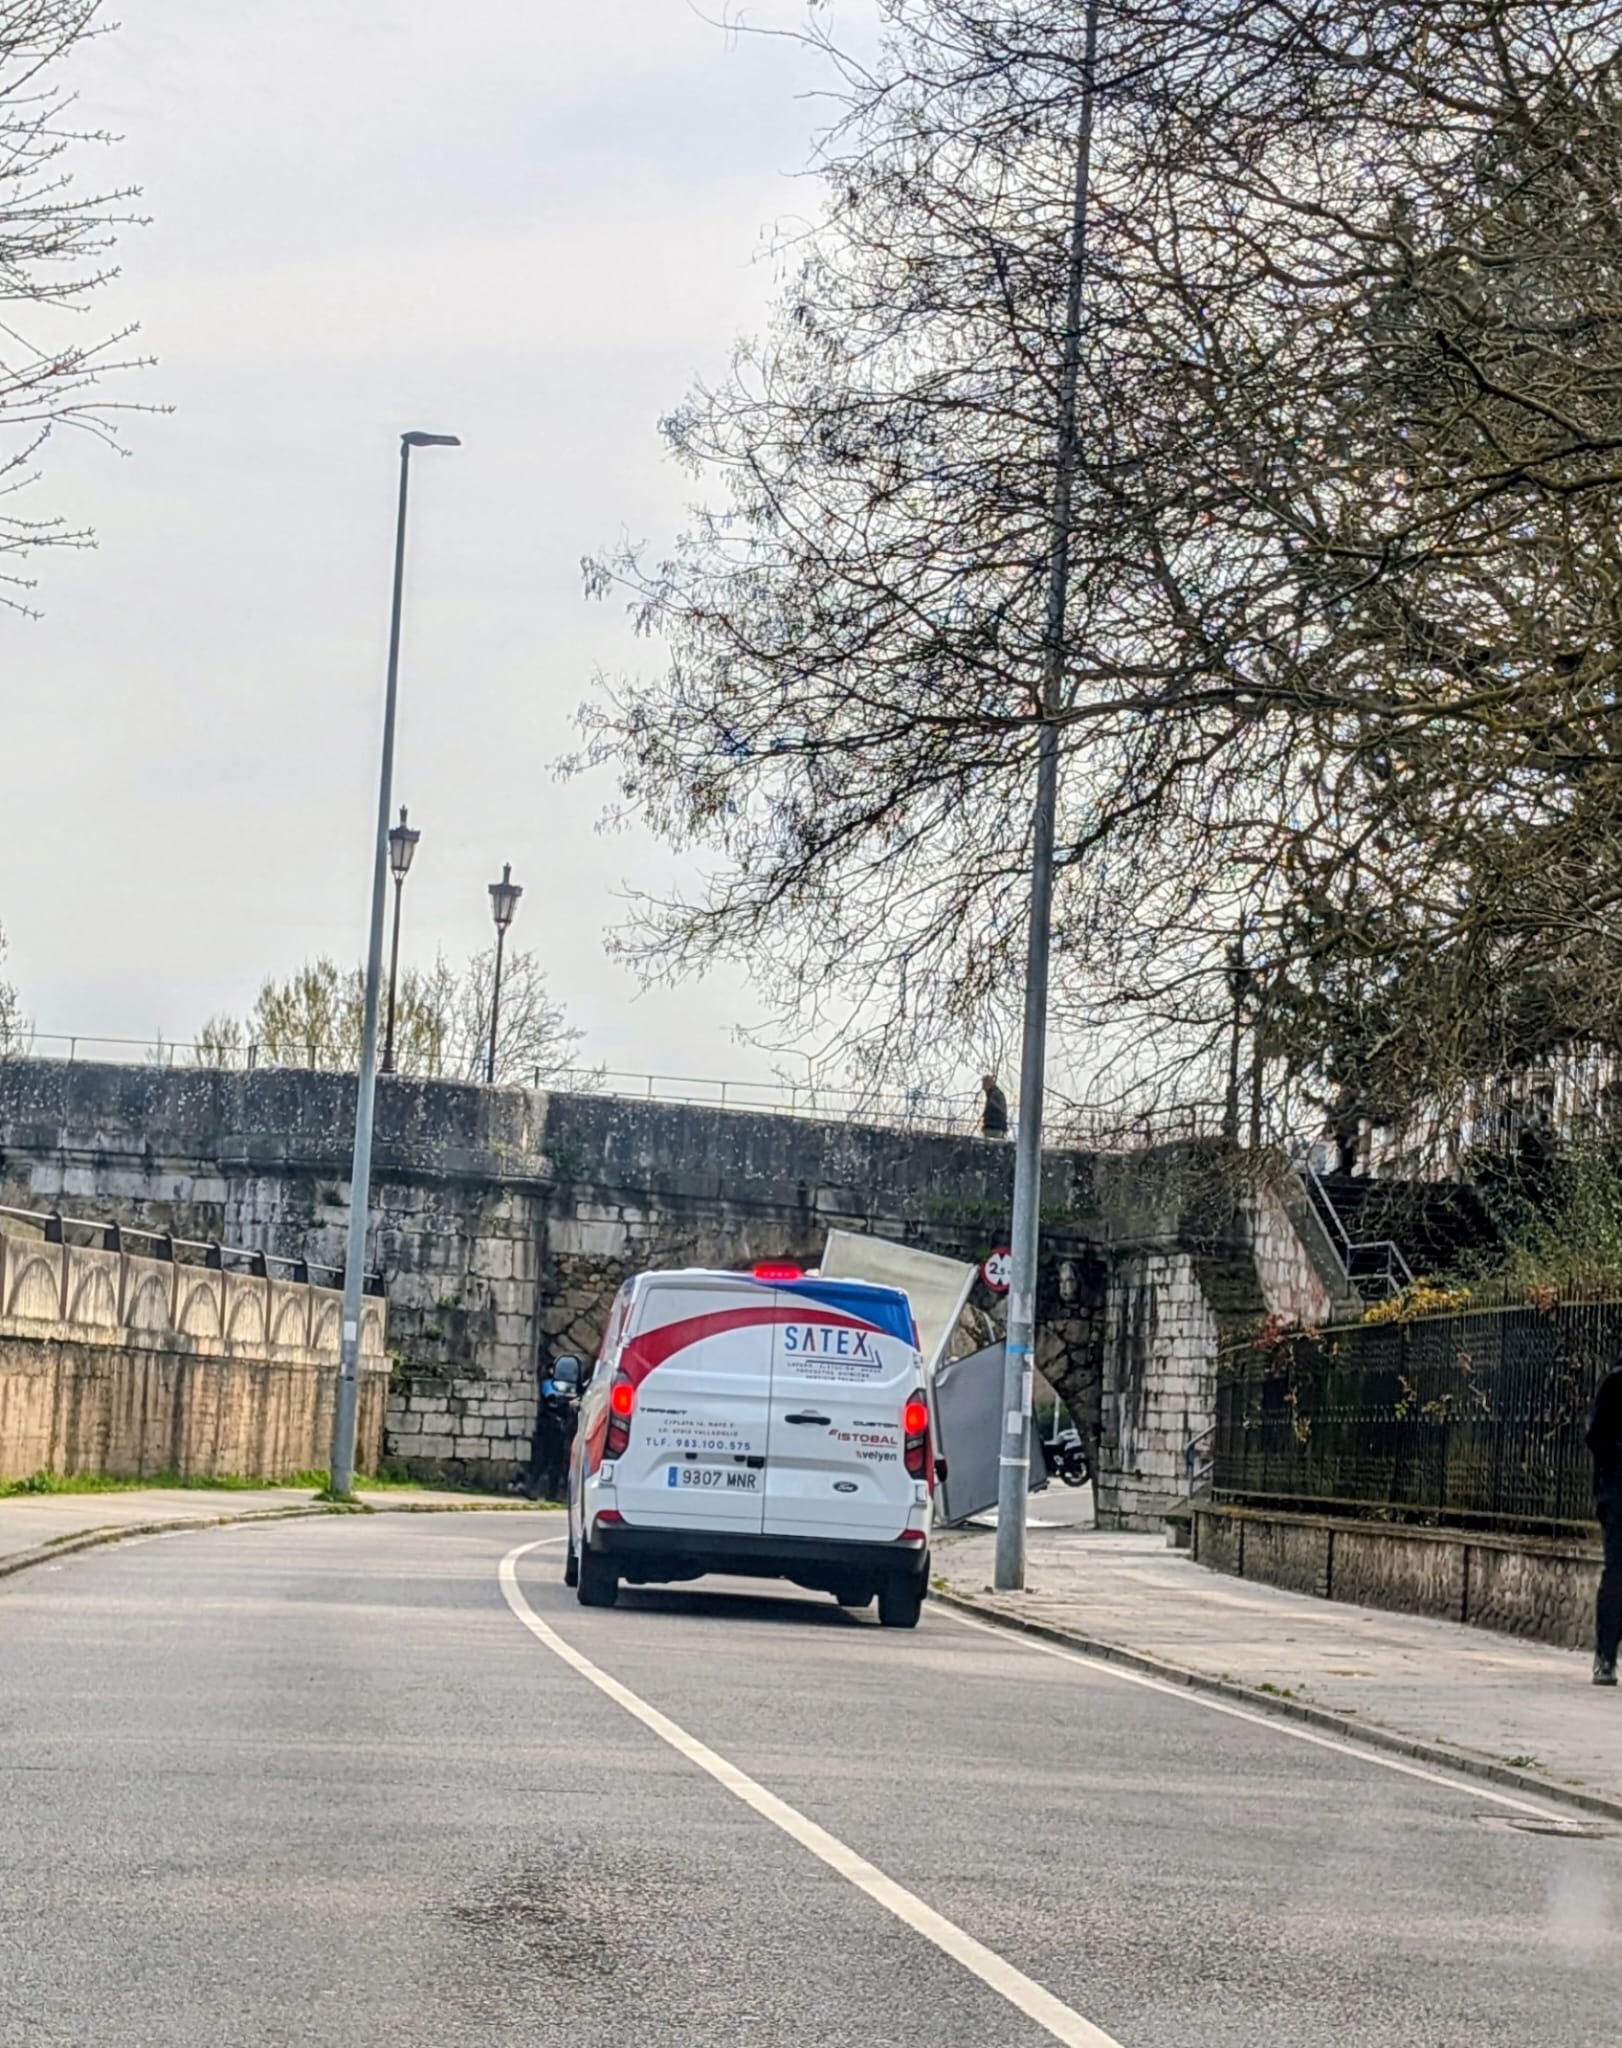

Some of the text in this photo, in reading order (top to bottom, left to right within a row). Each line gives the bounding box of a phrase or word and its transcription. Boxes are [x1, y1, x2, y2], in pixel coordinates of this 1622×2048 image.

[784, 1326, 868, 1357] SATEX
[837, 1432, 898, 1445] ISTOBAL
[862, 1451, 897, 1462] velyen
[682, 1470, 757, 1489] 9307 MNR
